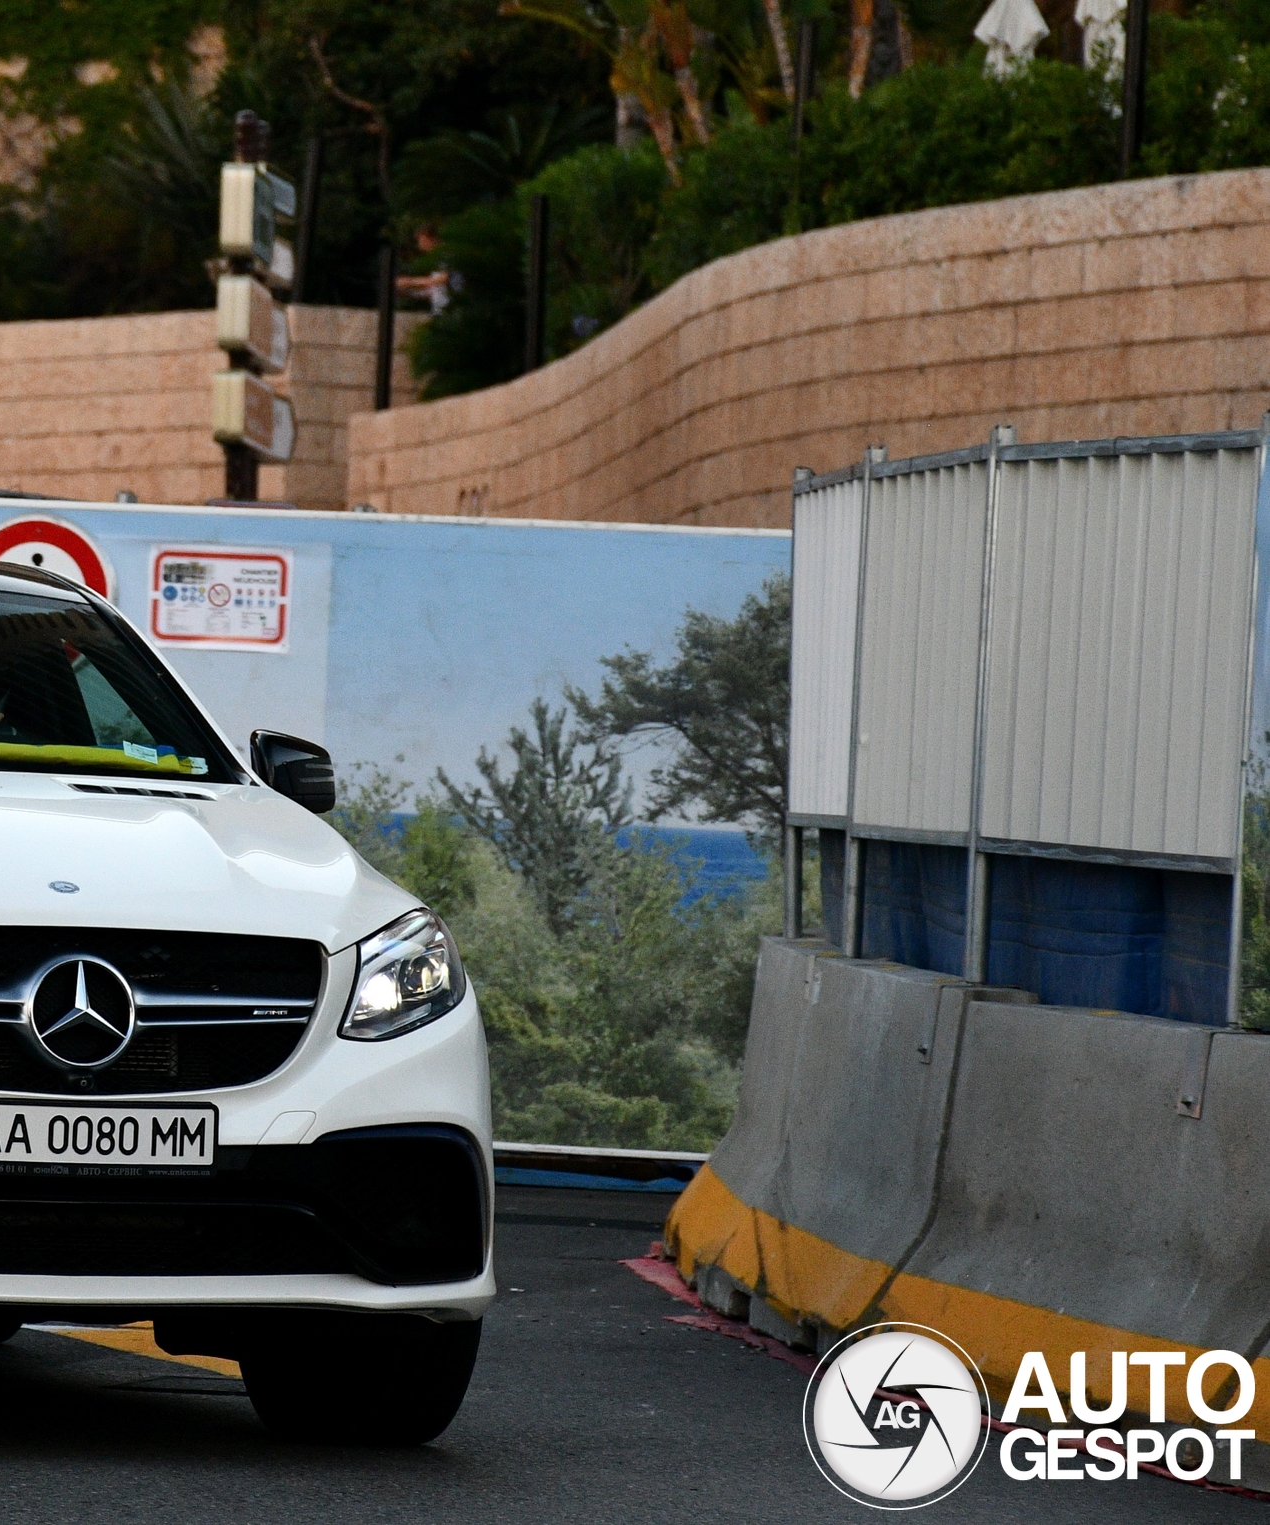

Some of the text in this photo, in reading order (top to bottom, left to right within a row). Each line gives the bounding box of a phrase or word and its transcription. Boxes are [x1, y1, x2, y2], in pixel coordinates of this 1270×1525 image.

[47, 1114, 140, 1156] 0080
[150, 1116, 206, 1157] MM
[5, 1164, 15, 1173] 01
[17, 1165, 27, 1174] 01
